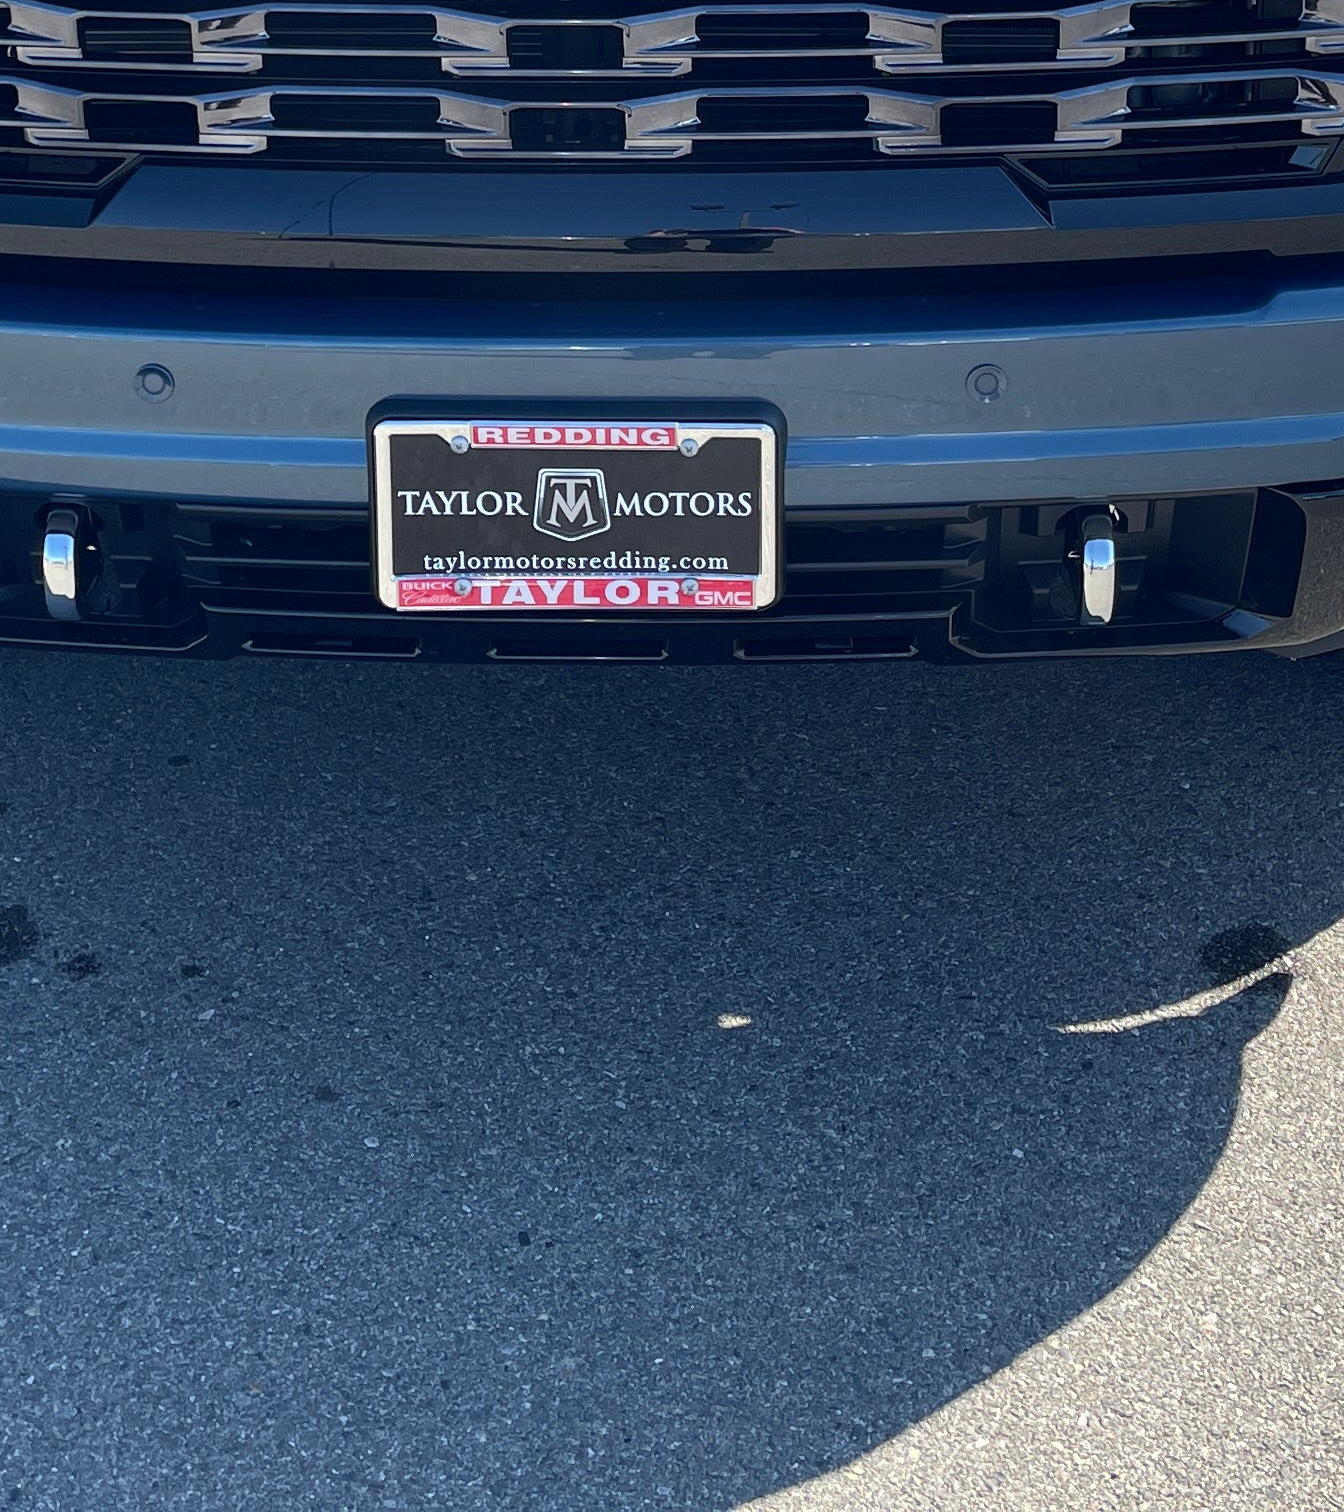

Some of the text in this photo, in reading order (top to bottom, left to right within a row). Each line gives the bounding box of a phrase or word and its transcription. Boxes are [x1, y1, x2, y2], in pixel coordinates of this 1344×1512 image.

[476, 426, 671, 446] REDDING
[397, 490, 529, 517] TAYLOR
[613, 491, 752, 517] MOTORS
[423, 551, 729, 574] taylormotorsredding.com
[402, 581, 453, 591] BUICK
[472, 580, 680, 605] TAYLOR
[401, 590, 462, 606] Cadillac
[694, 591, 752, 606] GMC
